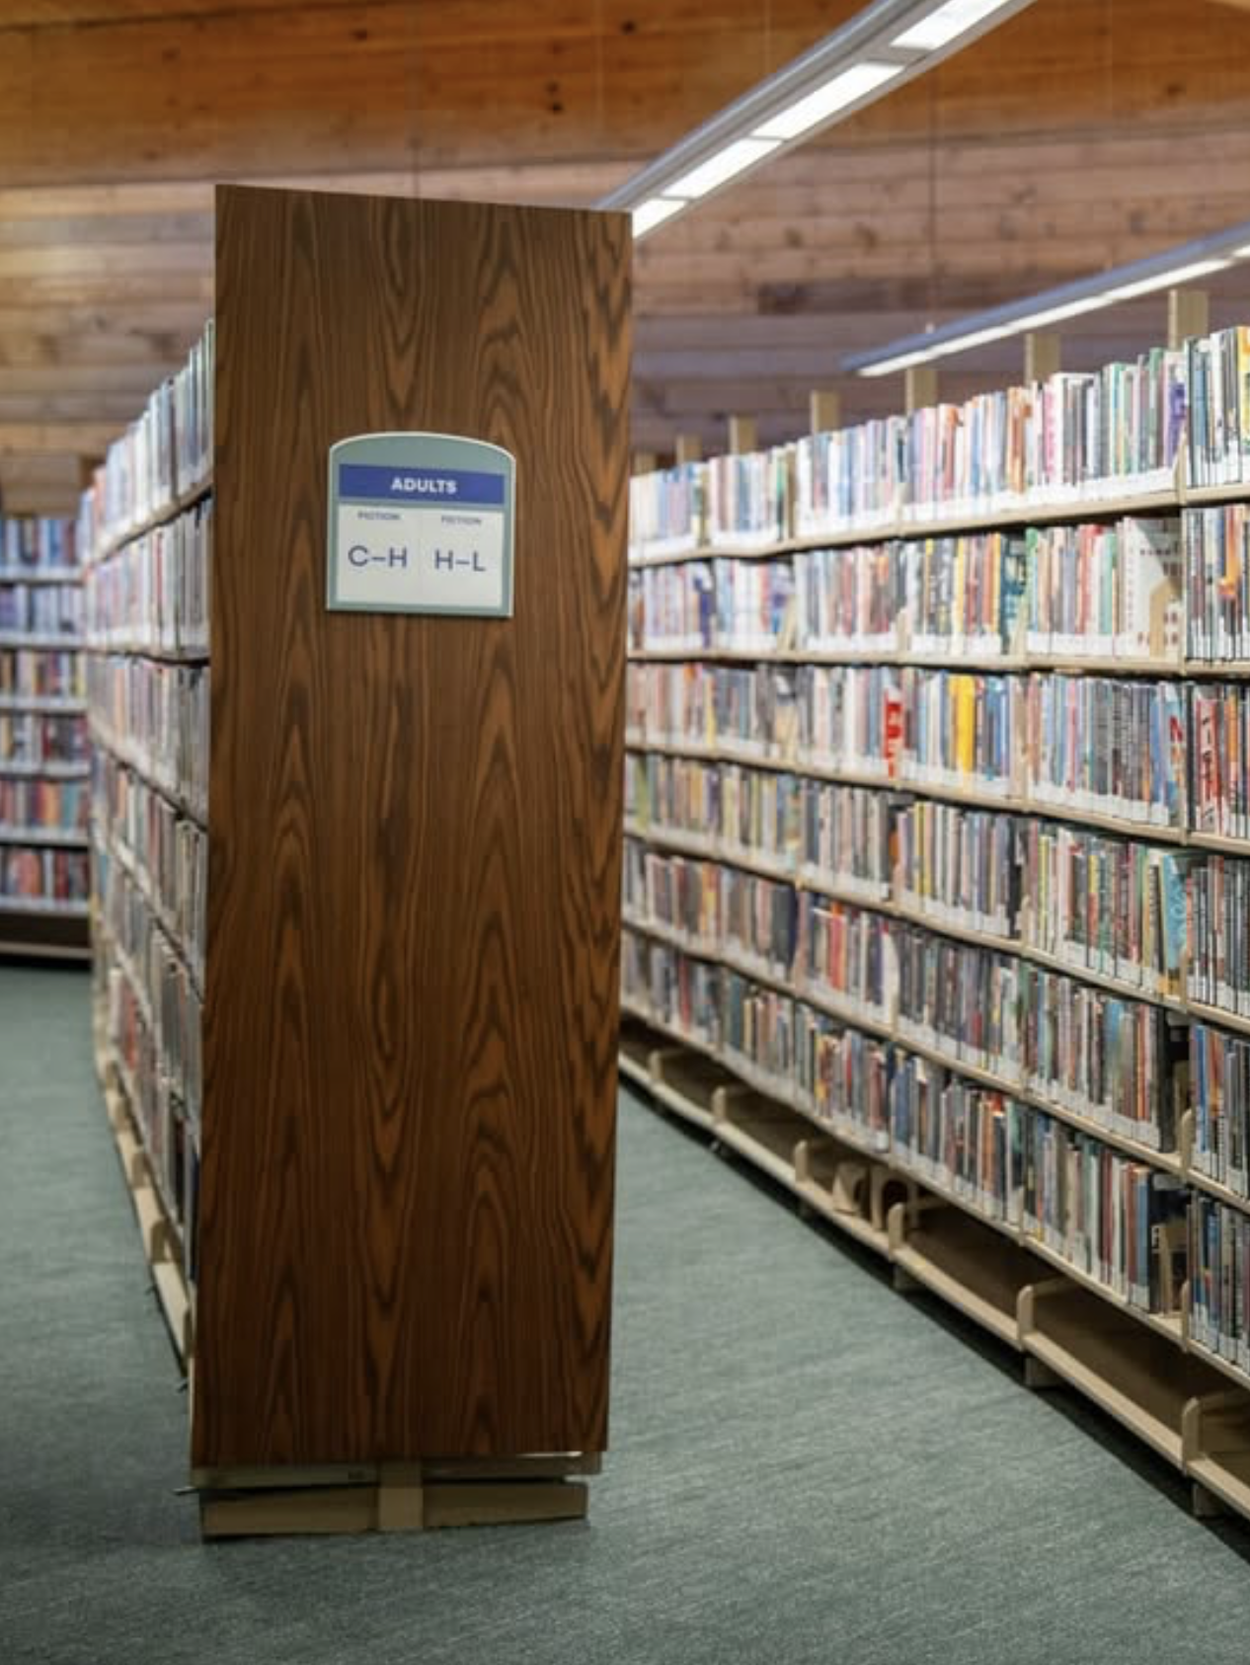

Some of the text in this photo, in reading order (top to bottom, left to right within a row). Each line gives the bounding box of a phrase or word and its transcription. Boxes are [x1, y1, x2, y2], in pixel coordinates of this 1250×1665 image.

[391, 476, 458, 494] ADULTS
[347, 545, 408, 568] C–H
[434, 549, 487, 572] H–L
